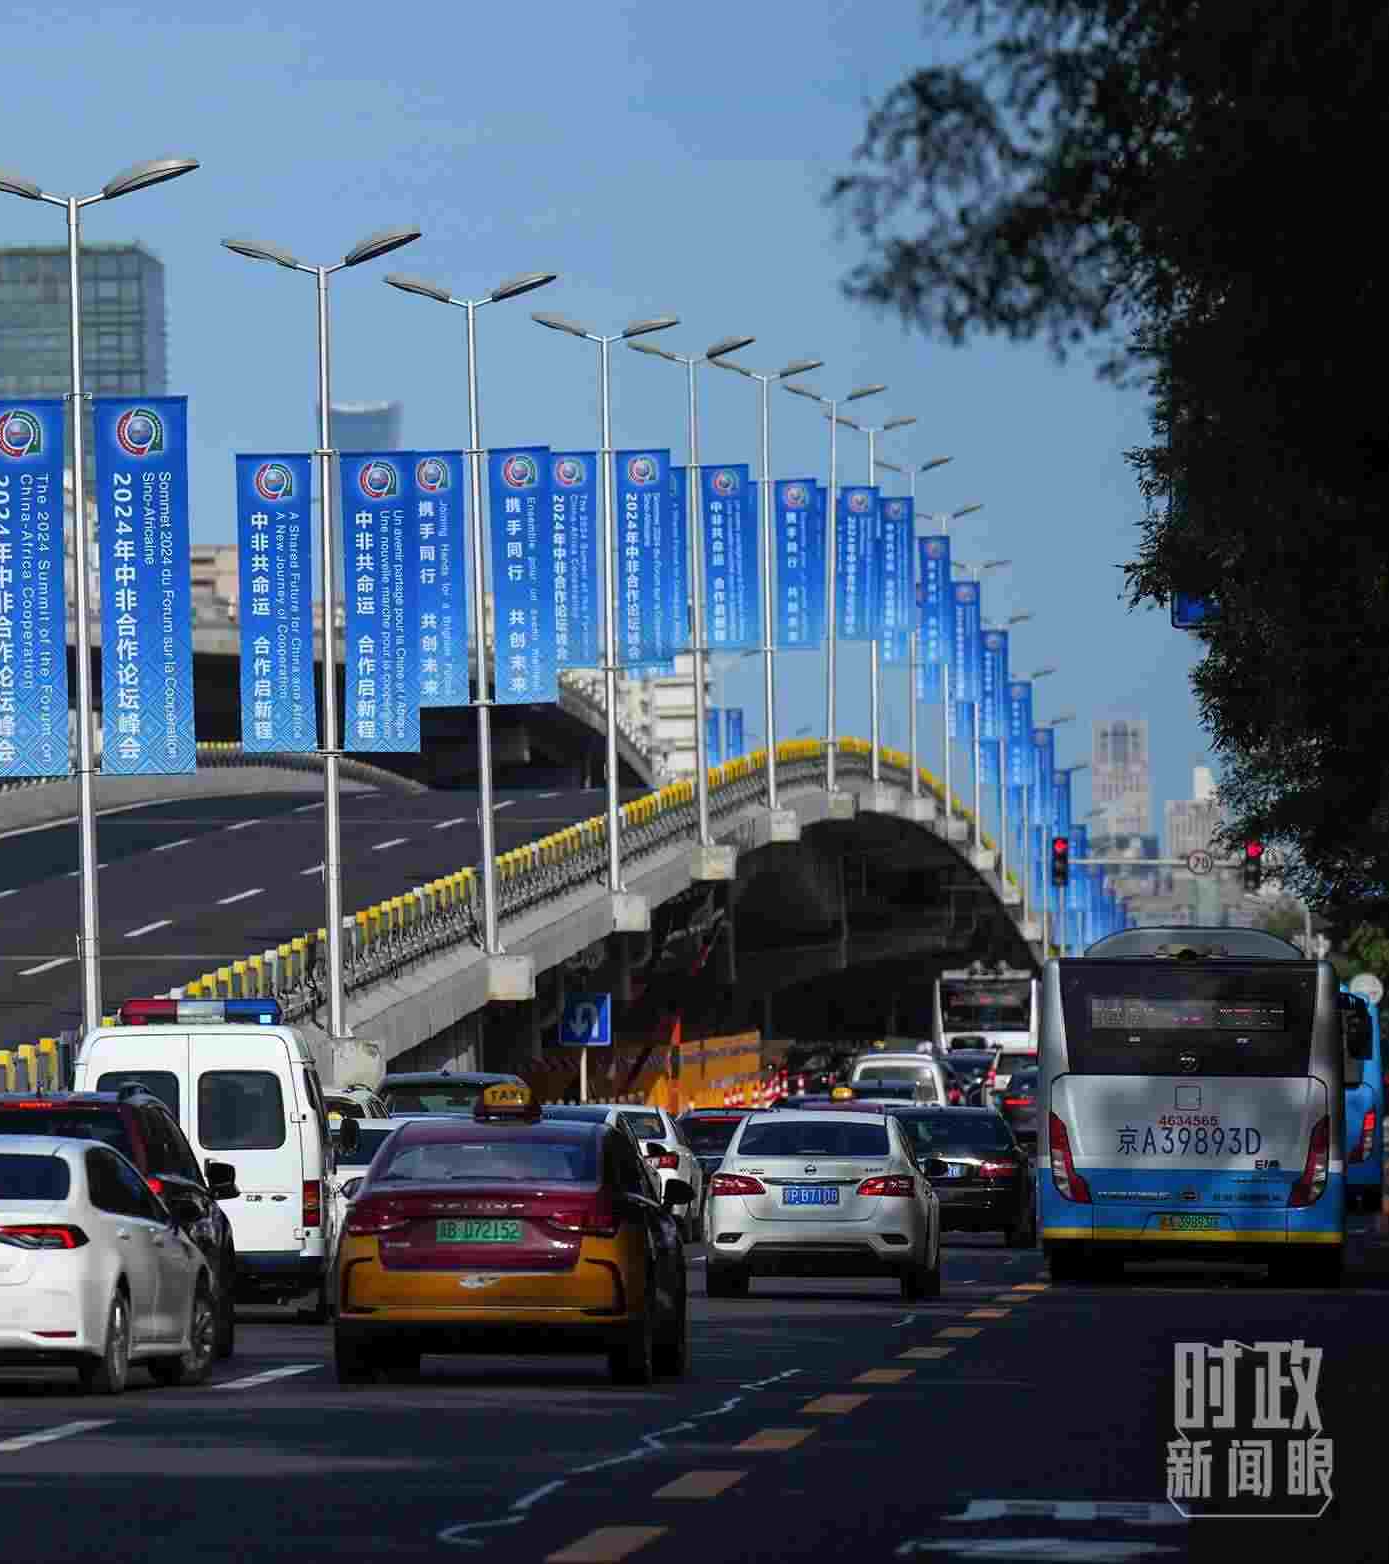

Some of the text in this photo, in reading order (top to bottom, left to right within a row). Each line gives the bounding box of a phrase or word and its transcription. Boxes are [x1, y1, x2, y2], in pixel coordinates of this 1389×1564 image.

[141, 472, 157, 566] Sino-Africaine
[158, 472, 172, 527] Sommet
[276, 512, 285, 520] A
[289, 512, 299, 521] A
[394, 510, 404, 526] Un
[159, 531, 174, 564] 2024
[276, 525, 286, 551] New
[289, 525, 300, 568] Shared
[19, 473, 36, 689] China-Africa Cooperation
[161, 569, 175, 585] du
[274, 555, 287, 604] Journey
[291, 573, 301, 611] Future
[36, 473, 54, 762] The 2024 Summit of the Forum on
[113, 473, 141, 760] 2024年中非合作论坛峰会
[162, 590, 176, 633] Forum
[251, 511, 273, 740] 中非共命运 合作启新程
[356, 510, 376, 738] 中非共命运 合作启新程
[163, 637, 174, 657] sur
[164, 661, 177, 673] la
[1117, 1125, 1262, 1156] 京A39893D
